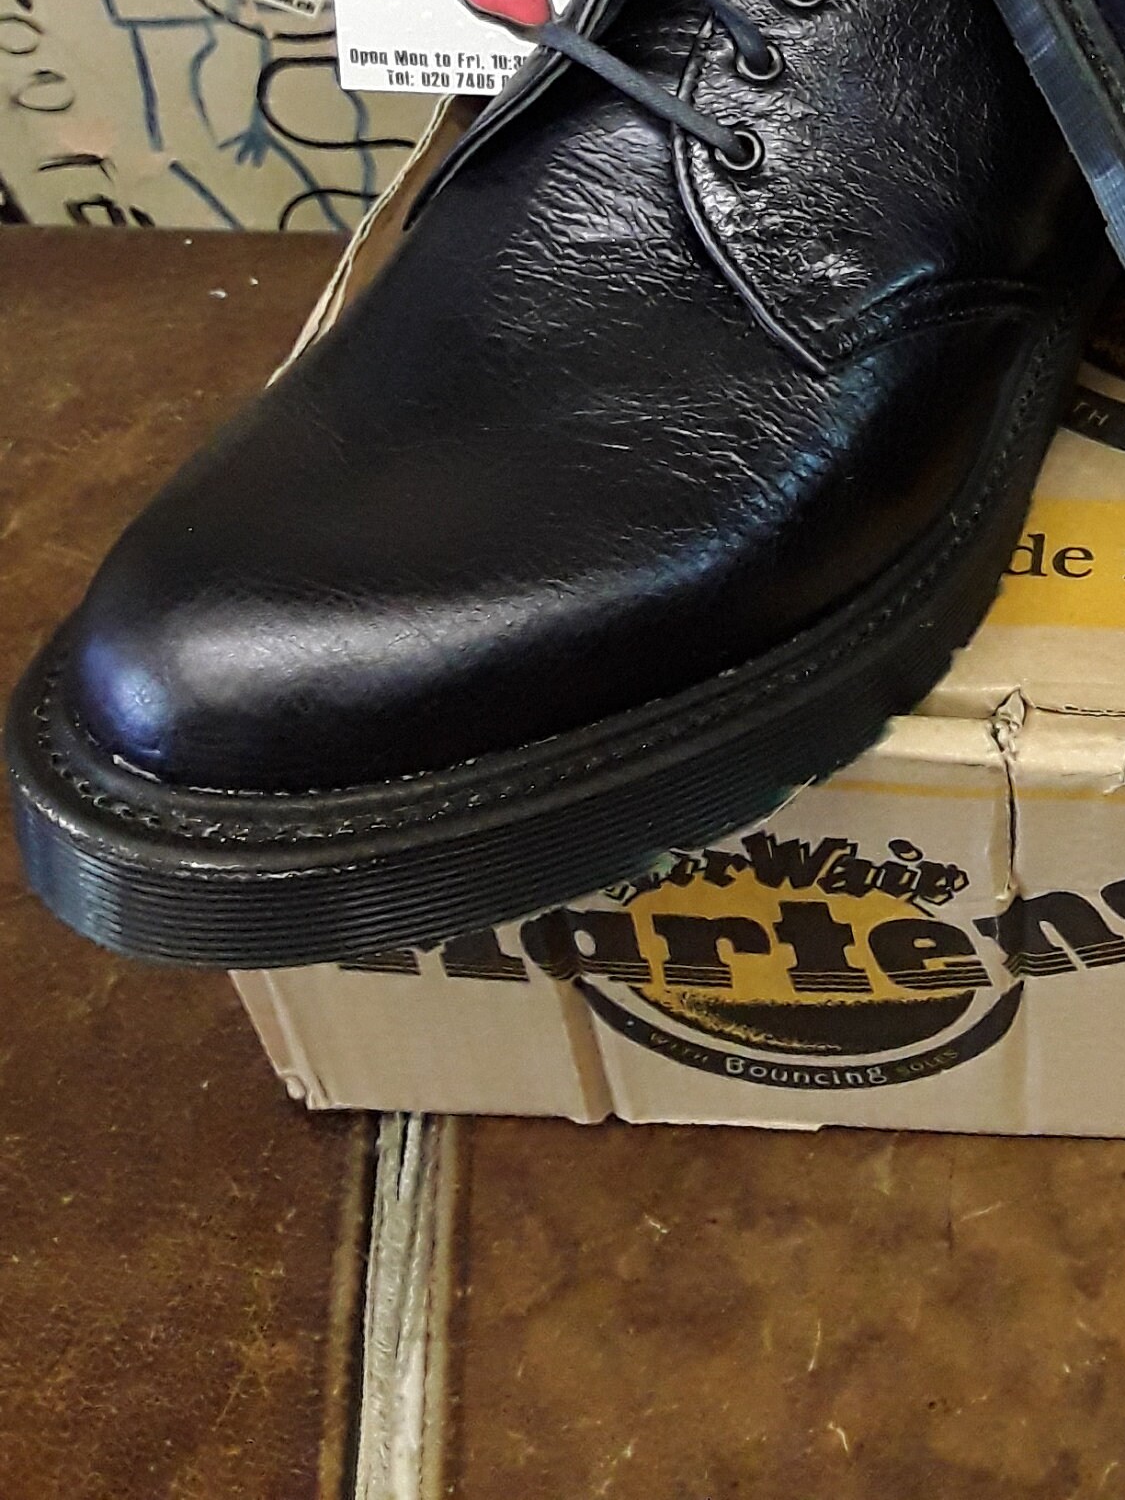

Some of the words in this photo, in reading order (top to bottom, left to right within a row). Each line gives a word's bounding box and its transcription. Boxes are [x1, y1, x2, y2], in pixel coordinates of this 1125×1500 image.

[349, 47, 389, 67] Open
[394, 49, 429, 68] Mon
[434, 52, 451, 68] to
[457, 52, 486, 71] Fri.
[421, 71, 450, 88] 020
[1002, 532, 1096, 580] de
[724, 1056, 889, 1086] Bouncing
